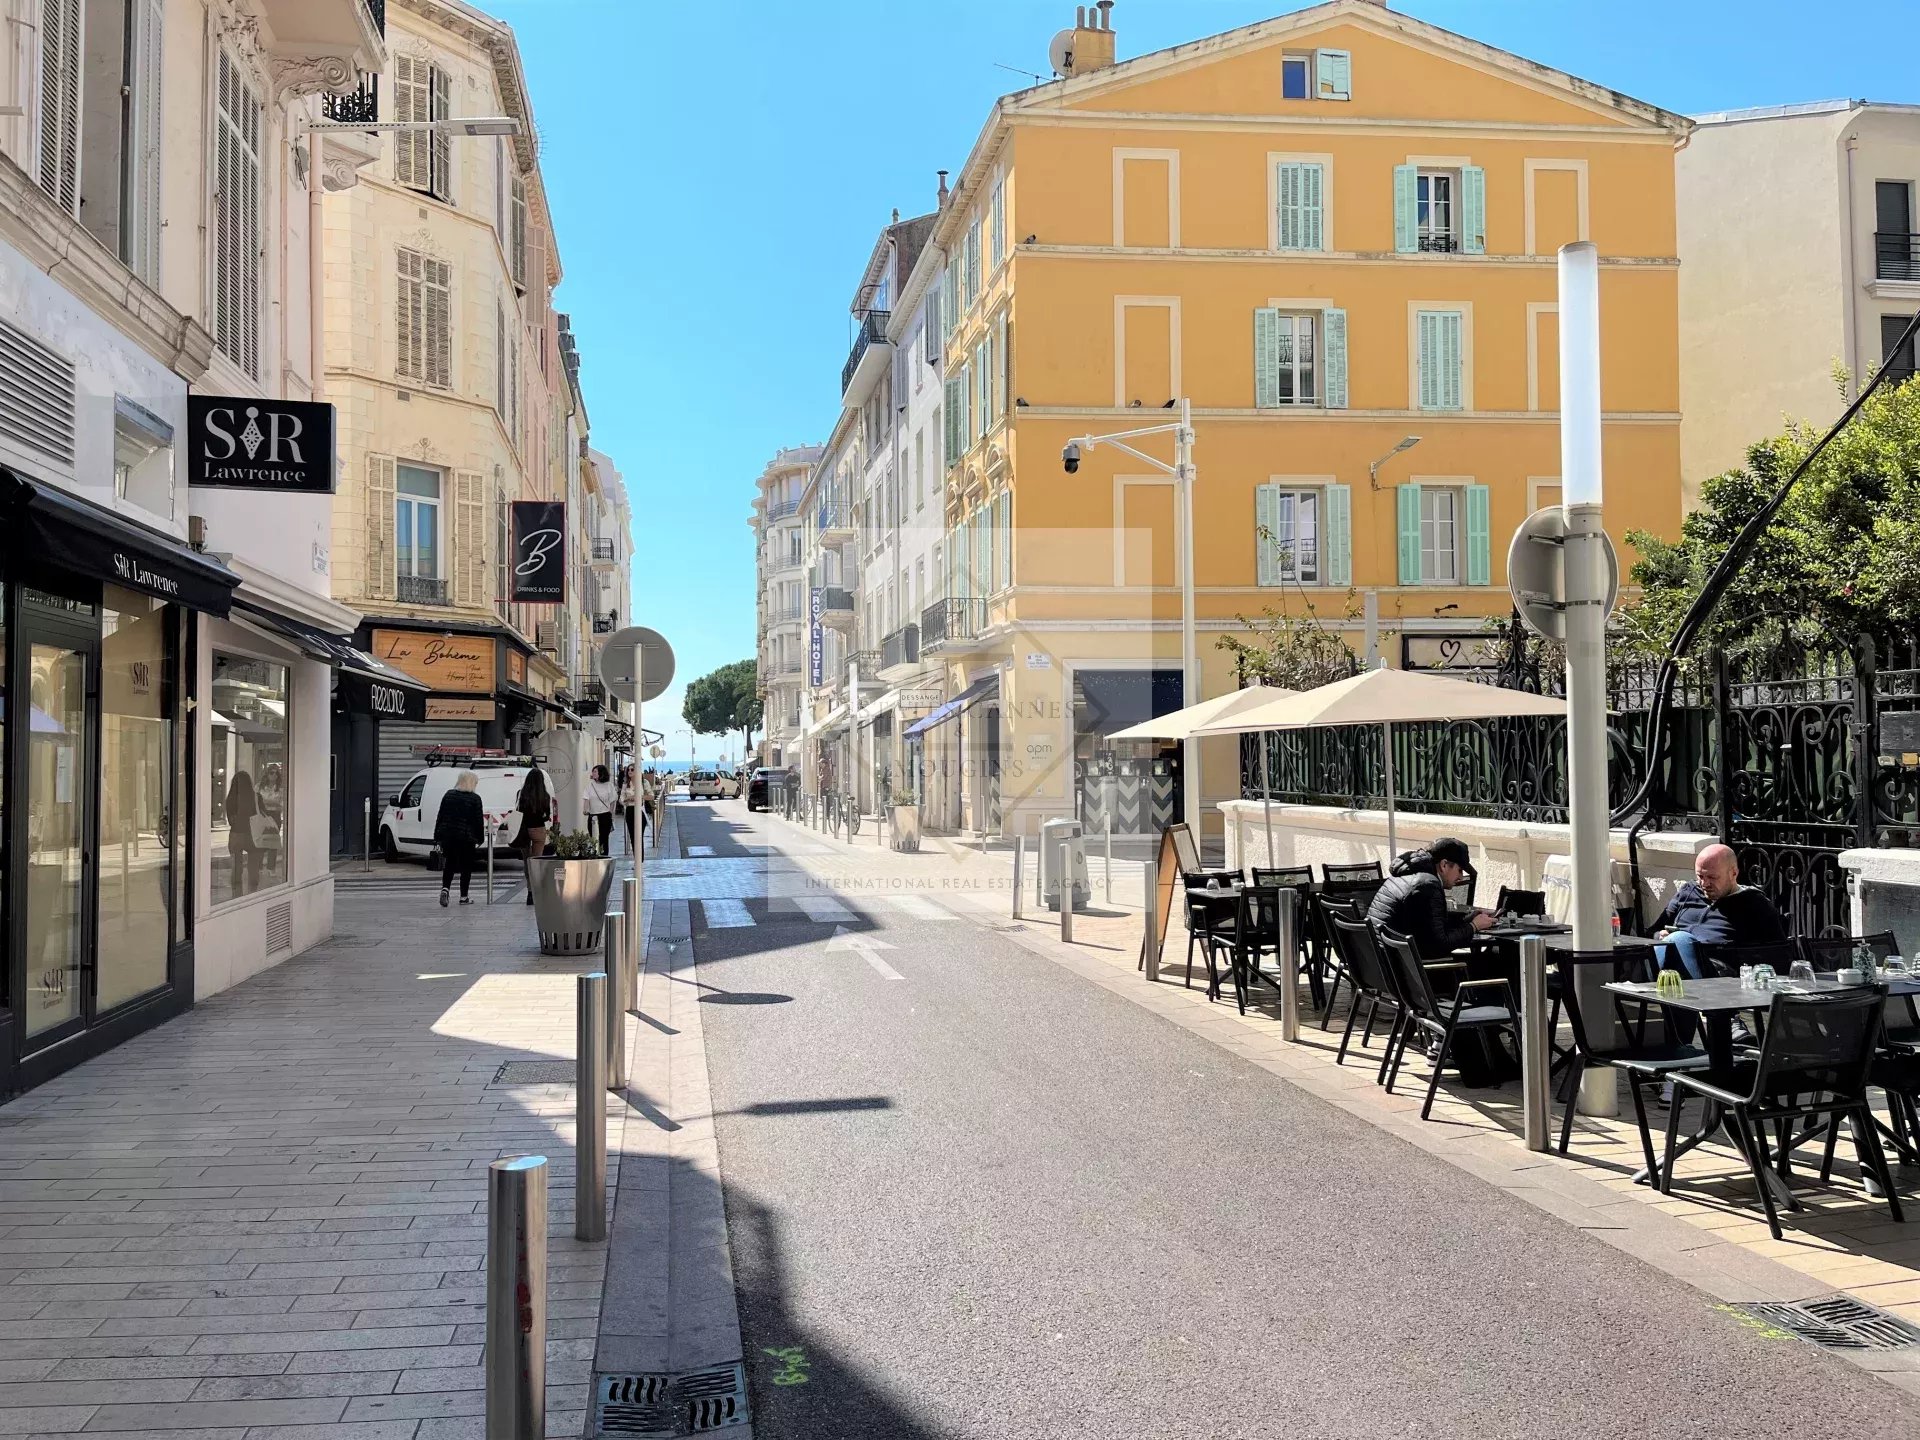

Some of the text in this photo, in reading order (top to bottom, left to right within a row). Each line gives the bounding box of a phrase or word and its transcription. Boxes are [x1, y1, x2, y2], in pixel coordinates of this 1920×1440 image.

[204, 461, 306, 482] Lawrence
[515, 529, 562, 575] B
[133, 560, 178, 595] Lawrence
[812, 596, 820, 639] ROYAL
[384, 637, 411, 660] La
[812, 643, 820, 686] HOTEL
[1026, 744, 1052, 756] apm
